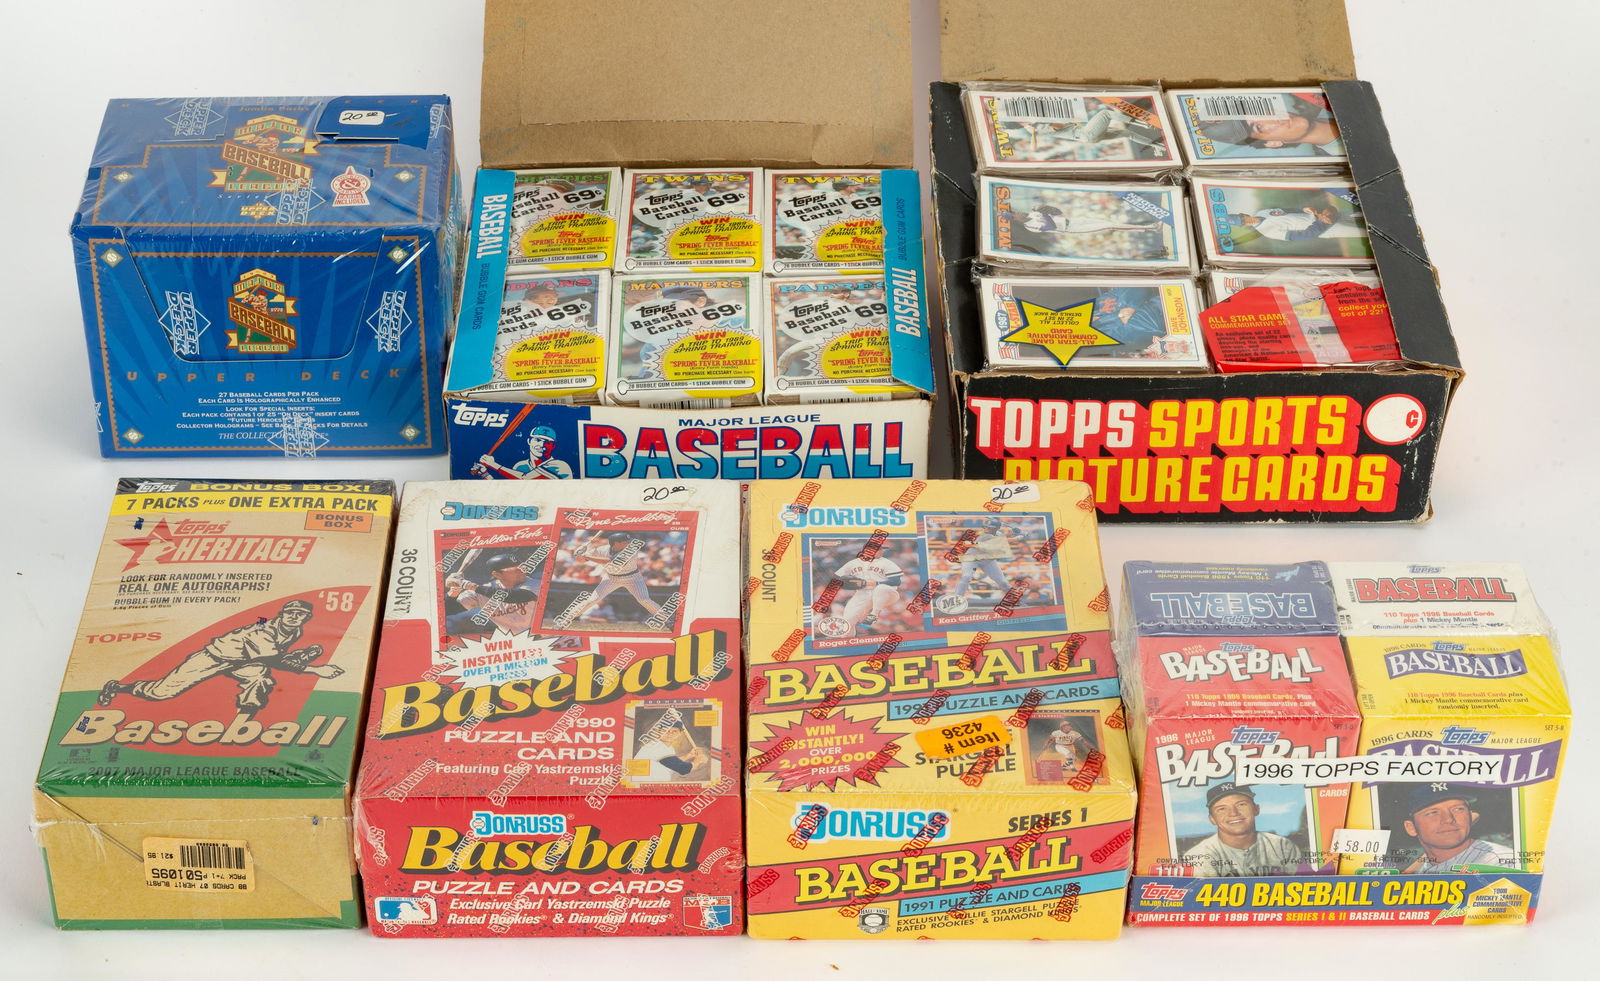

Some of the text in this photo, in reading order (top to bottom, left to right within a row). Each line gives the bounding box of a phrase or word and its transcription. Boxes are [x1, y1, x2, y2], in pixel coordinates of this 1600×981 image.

[224, 142, 311, 181] BASEBALL
[640, 175, 747, 183] TWINS
[640, 195, 702, 215] Baseball
[645, 192, 683, 206] Topps
[655, 206, 699, 220] Cards
[784, 198, 847, 218] Baseball
[800, 209, 843, 222] Cards
[700, 217, 730, 225] WIN
[996, 186, 1012, 249] METS
[1210, 189, 1234, 253] CUBS
[476, 194, 507, 259] BASEBALL
[636, 304, 676, 317] Topps
[789, 302, 830, 317] Topps
[891, 267, 922, 338] BASEBALL
[180, 292, 199, 354] UPPER
[230, 301, 295, 347] BASEBALL
[630, 304, 742, 329] Baseball 69¢
[785, 305, 851, 329] Baseball
[1208, 312, 1288, 323] ALL STAR GAME
[649, 320, 693, 335] Cards
[802, 319, 847, 335] Cards
[1210, 321, 1274, 329] COMMEMORATIVE
[695, 331, 727, 340] WIN
[674, 340, 752, 353] SPRING TRAINING
[127, 369, 400, 382] UPPER DECK
[451, 402, 509, 428] Topps
[678, 413, 821, 427] MAJOR LEAGUE
[970, 396, 1350, 450] TOPPS SPORTS
[580, 421, 914, 480] BASEBALL
[1220, 454, 1390, 502] CARDS
[189, 483, 372, 492] BONUS BOX!
[643, 487, 669, 502] 20
[142, 496, 201, 510] PACKS
[229, 496, 263, 508] ONE
[269, 496, 325, 509] EXTRA
[332, 498, 378, 512] PACK
[316, 513, 364, 522] BONUS
[323, 521, 353, 529] BOX
[174, 518, 230, 536] Topps
[171, 536, 311, 563] HERITAGE
[149, 575, 167, 583] FOR
[169, 573, 223, 582] RANDOMLY
[225, 573, 273, 581] INSERTED
[761, 563, 777, 602] COUNT
[118, 581, 271, 593] REAL ONE AUTOGRAPHS!
[395, 566, 416, 614] COUNT
[1353, 577, 1517, 603] BASEBALL
[213, 596, 241, 604] PACK!
[1150, 592, 1317, 618] BASEBALL
[87, 631, 163, 645] TOPPS
[484, 639, 513, 652] WIN
[1159, 647, 1324, 683] BASEBALL
[1387, 650, 1522, 677] BASEBALL
[763, 639, 1095, 710] BASEBALL
[380, 628, 728, 740] Baseball
[58, 709, 350, 747] Baseball
[569, 717, 616, 728] 1990
[805, 724, 837, 736] WIN
[941, 721, 983, 740] 4236
[444, 731, 615, 744] PUZZLE AND
[959, 729, 1002, 751] Item
[1230, 725, 1283, 745] Topps
[1371, 730, 1433, 747] 1996 CARDS
[1440, 725, 1495, 746] Topps
[517, 748, 615, 760] CARDS
[810, 746, 842, 756] OVER
[778, 750, 879, 769] 2,000,000
[124, 766, 302, 777] MAJOR LEAGUE BASEBALL
[435, 763, 617, 775] Featuring Yastrzemski
[810, 765, 851, 776] PRIZES
[935, 758, 1016, 778] PUZZLE
[1243, 761, 1499, 779] 1996 TOPPS FACTORY
[1319, 789, 1348, 798] CARDS
[1008, 809, 1073, 833] SERIES
[397, 823, 708, 875] Baseball
[1344, 841, 1380, 853] 58.00
[151, 868, 202, 880] 501095
[794, 836, 1086, 903] BASEBALL
[412, 880, 685, 895] PUZZLE AND CARDS
[1141, 882, 1189, 900] Topps
[1195, 880, 1467, 907] 440 BASEBALL CARDS
[450, 898, 671, 911] Exclusive Puzzle
[905, 887, 1030, 913] 1991 AND
[447, 913, 626, 925] Rated Diamond
[896, 904, 1039, 926] EXCLUSIVE STARGELL
[992, 912, 1043, 924] DIAMOND
[1136, 914, 1186, 922] COMPLETE
[1189, 913, 1206, 921] SET
[1225, 913, 1249, 921] 1996
[1252, 913, 1283, 921] TOPPS
[1286, 912, 1318, 921] SERIES
[1349, 912, 1395, 920] BASEBALL
[1399, 911, 1430, 920] CARDS
